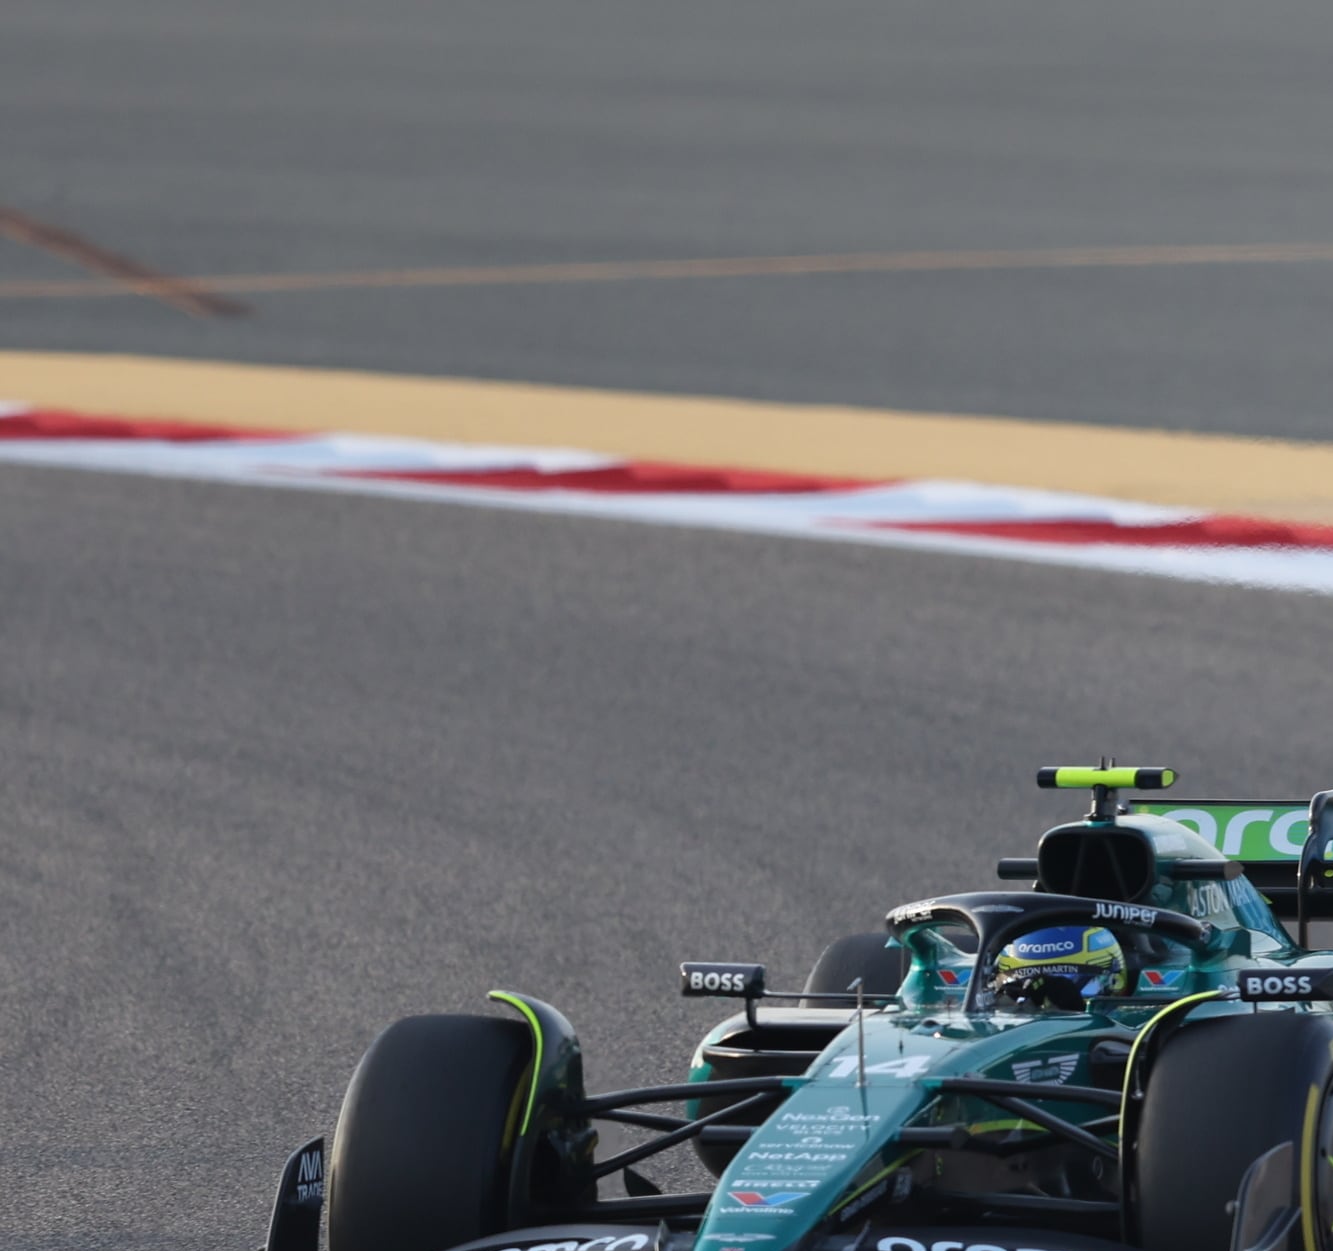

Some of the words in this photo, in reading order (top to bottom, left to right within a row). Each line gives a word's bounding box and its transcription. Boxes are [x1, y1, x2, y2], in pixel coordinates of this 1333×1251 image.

[1018, 941, 1074, 953] aramco
[1014, 967, 1041, 978] ASTON
[1042, 965, 1079, 974] MARTIN
[690, 972, 745, 991] BOSS
[1247, 976, 1312, 995] BOSS
[829, 1055, 931, 1078] 14
[782, 1113, 880, 1121] NexGen
[748, 1151, 847, 1161] NetApp
[719, 1206, 795, 1214] Valvoline
